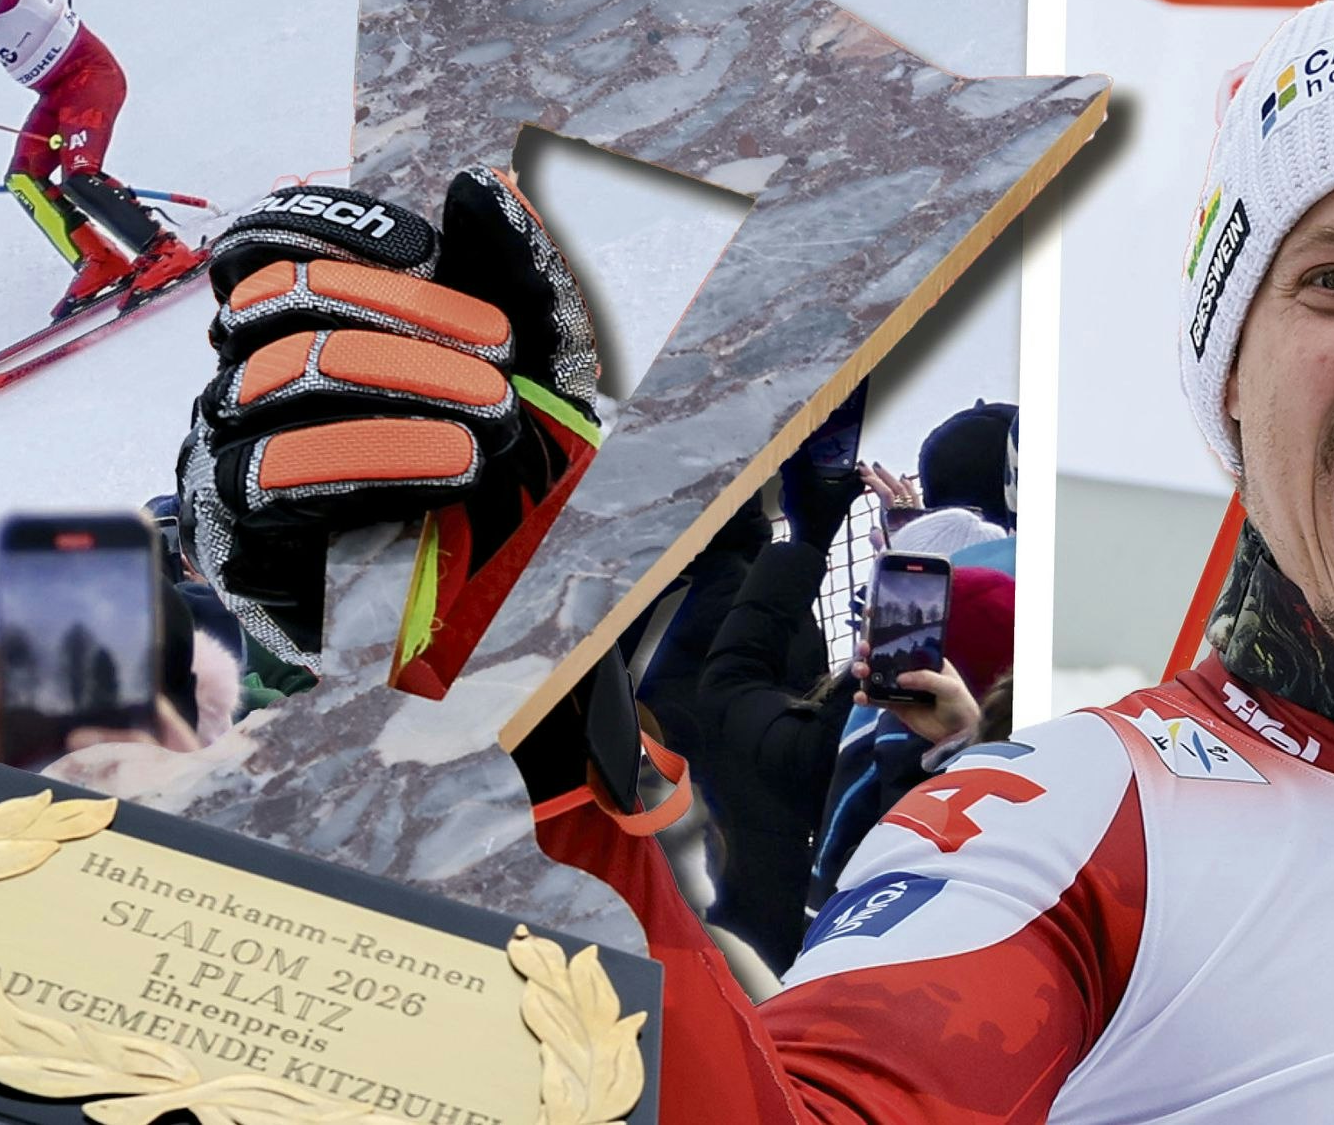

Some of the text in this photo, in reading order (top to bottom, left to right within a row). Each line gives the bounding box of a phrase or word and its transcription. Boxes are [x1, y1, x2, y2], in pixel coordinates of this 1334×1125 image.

[1192, 211, 1245, 348] GIESSWEIN
[1222, 681, 1322, 764] Tirol
[80, 851, 487, 994] Hahnenkamm-Rennen
[102, 898, 427, 1018] SLALOM 2026
[139, 978, 329, 1054] Ehrenpreis
[151, 951, 354, 1033] 1. PLATZ
